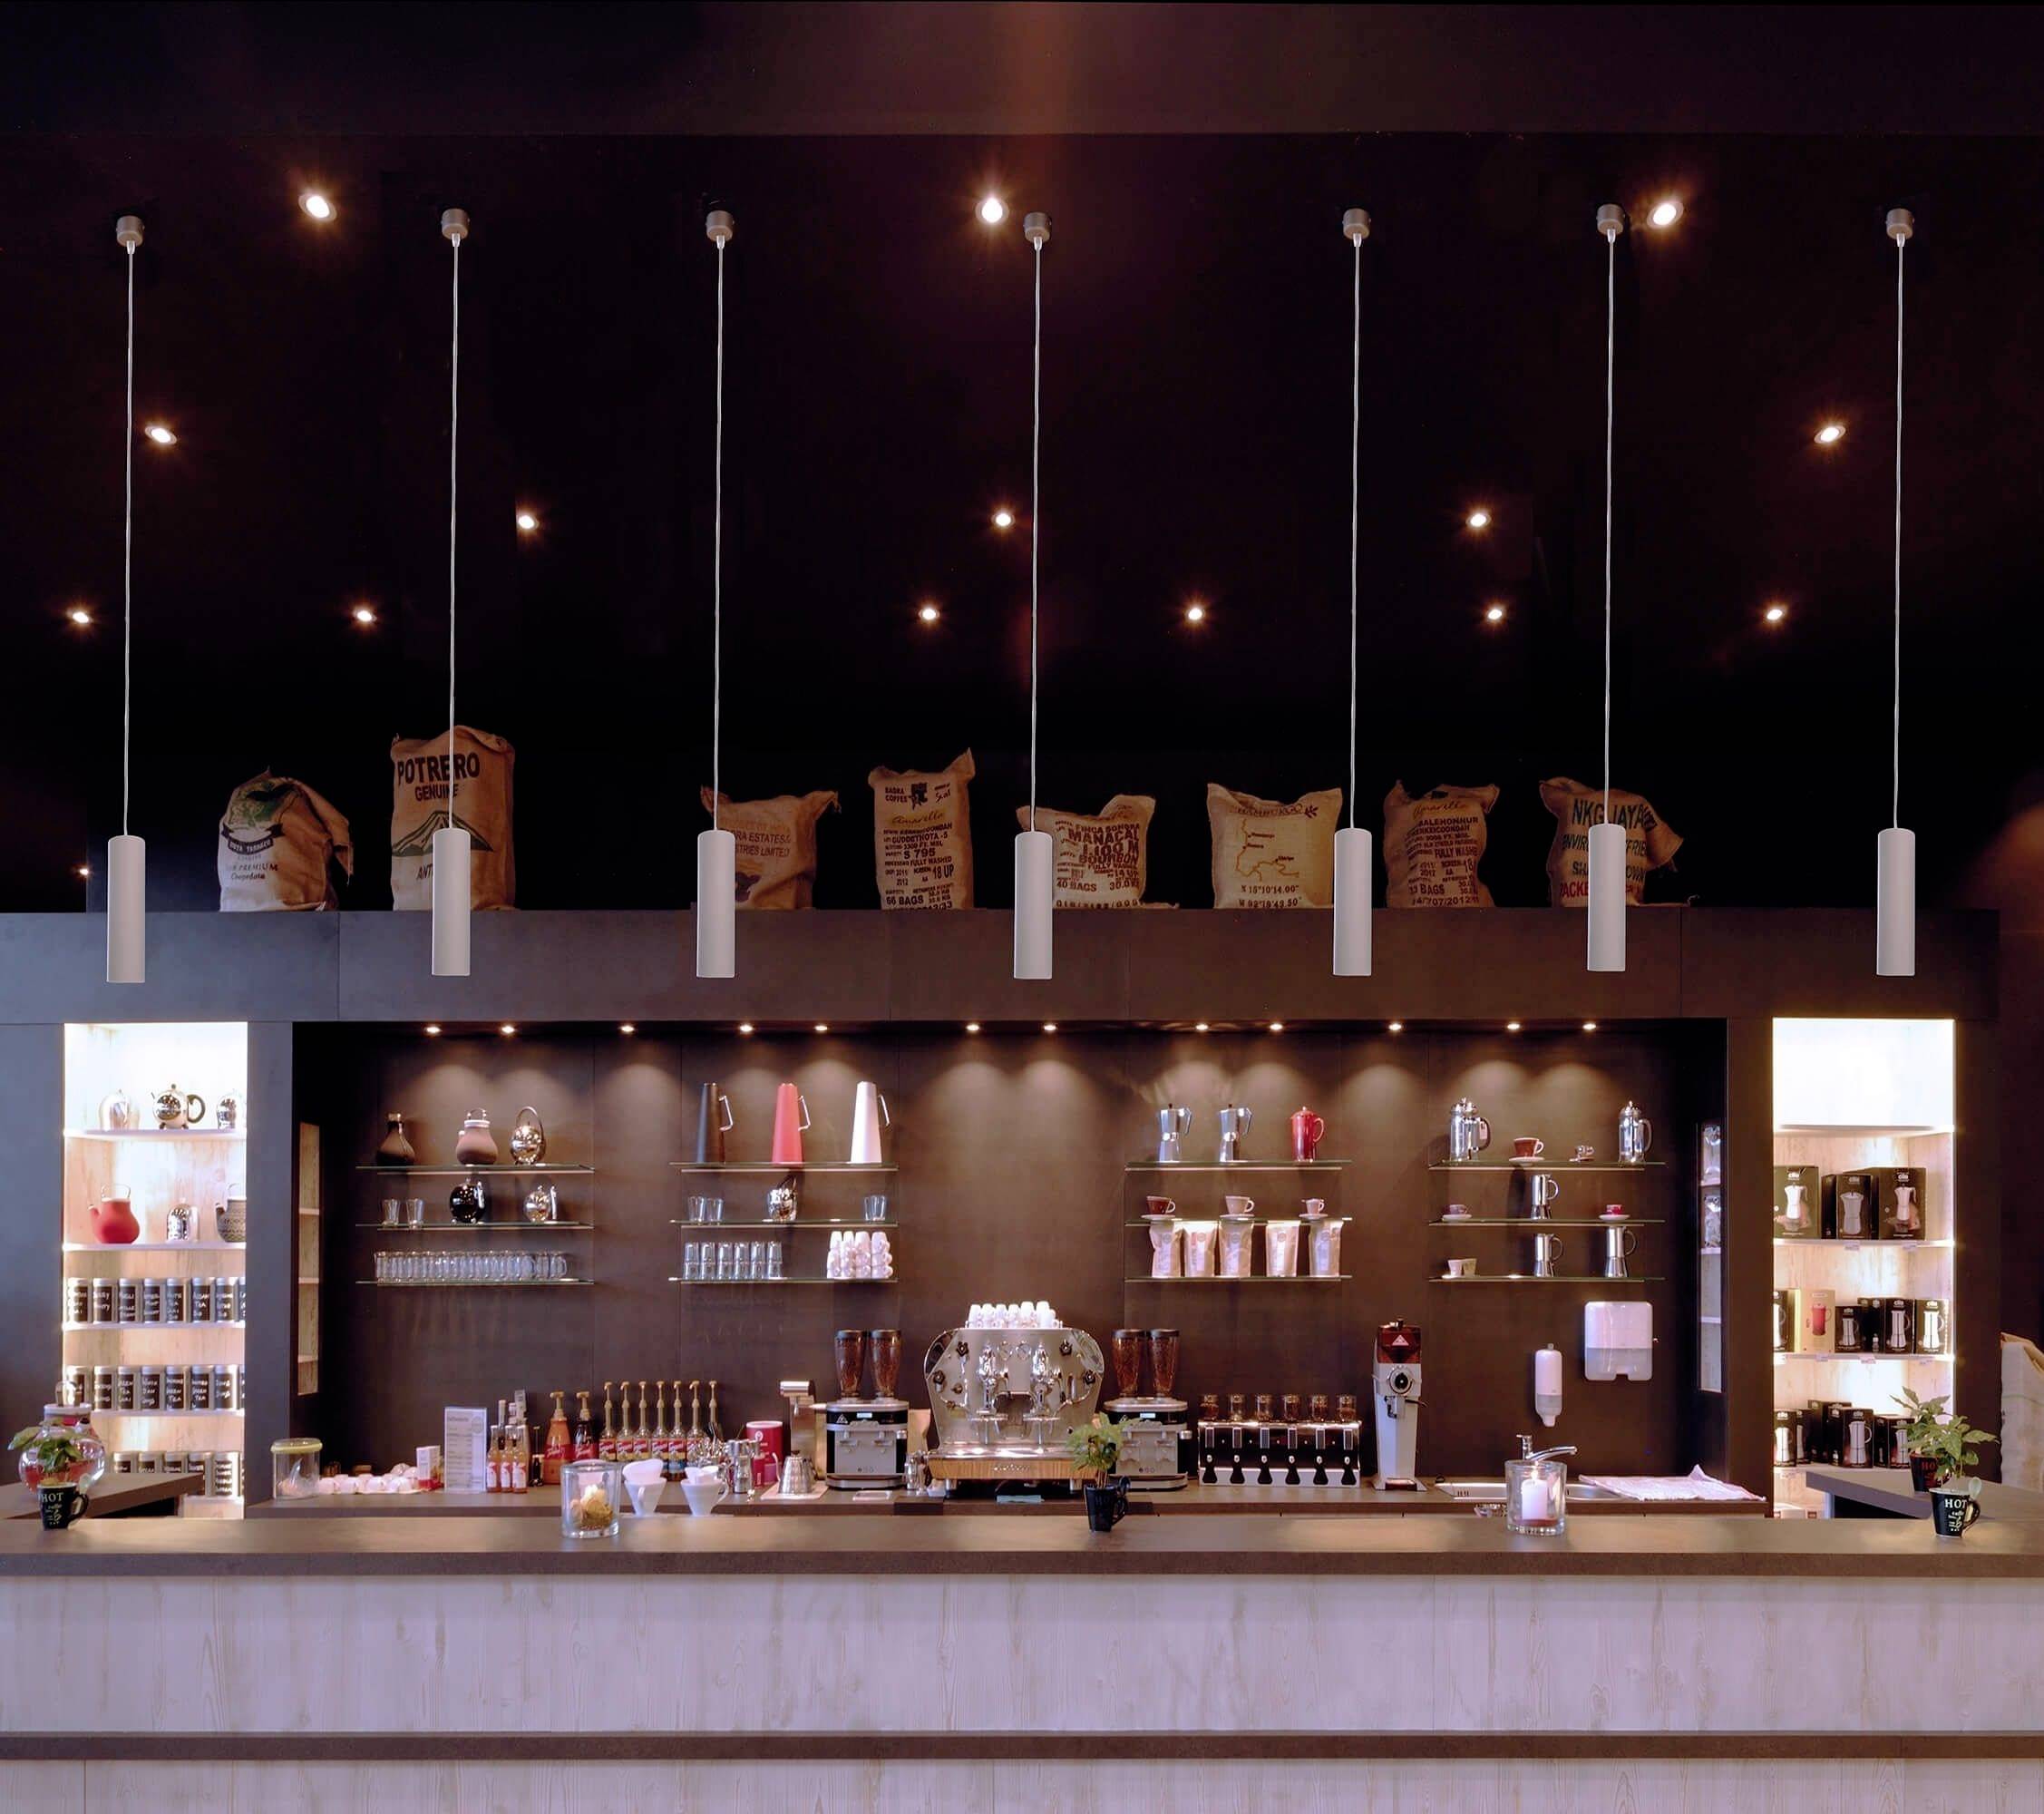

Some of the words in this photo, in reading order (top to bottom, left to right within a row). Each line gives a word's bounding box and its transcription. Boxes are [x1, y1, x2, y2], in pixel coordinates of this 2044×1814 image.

[397, 752, 481, 786] POTRERO
[1572, 797, 1604, 826] NKG
[913, 847, 937, 859] 795
[944, 863, 955, 879] UP
[898, 894, 925, 906] BAGS
[1922, 1461, 1936, 1470] HO
[42, 1492, 64, 1503] HOT
[1944, 1497, 1968, 1509] HOT
